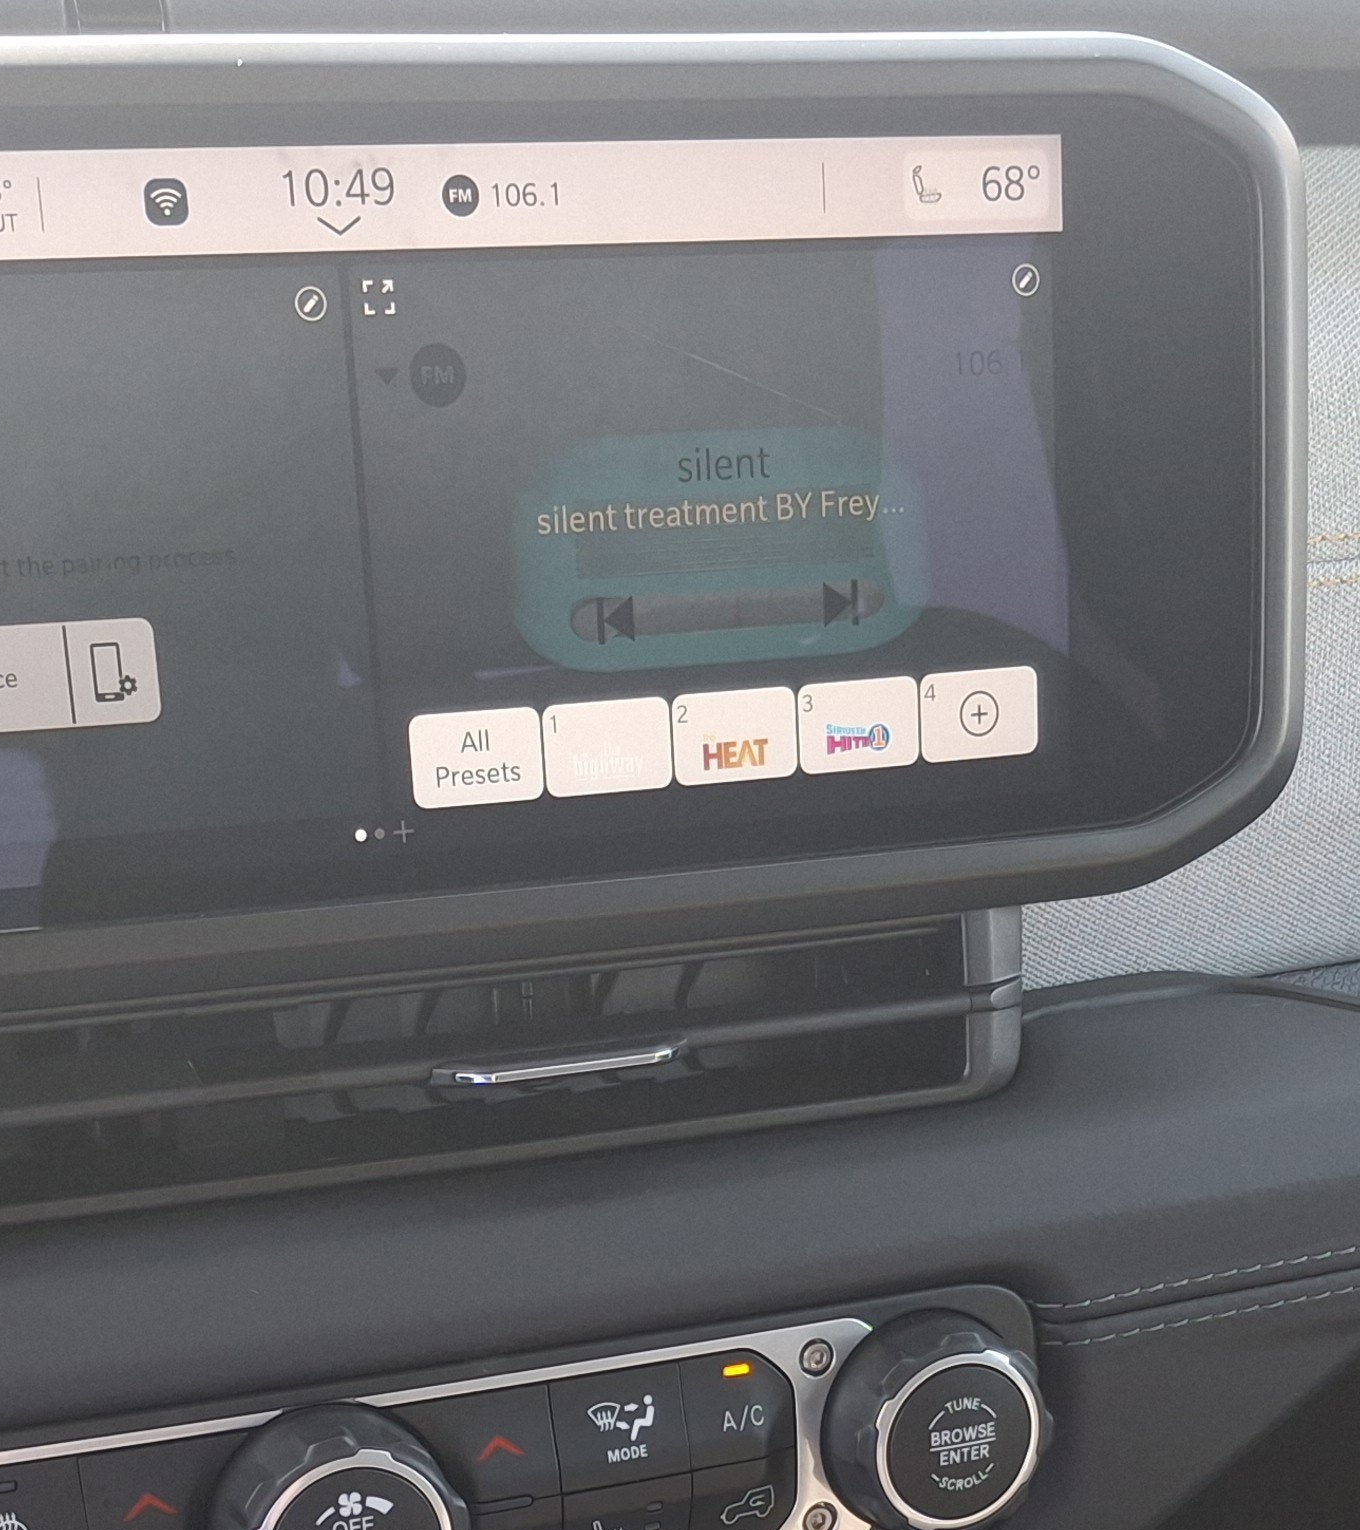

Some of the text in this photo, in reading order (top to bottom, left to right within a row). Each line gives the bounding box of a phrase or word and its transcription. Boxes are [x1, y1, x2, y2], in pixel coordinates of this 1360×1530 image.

[281, 165, 396, 208] 10:49
[447, 180, 561, 208] FM 106.1
[980, 164, 1041, 202] 68°
[419, 363, 455, 387] FM
[676, 446, 772, 484] silent
[536, 502, 618, 535] silent
[623, 495, 769, 531] treatment
[775, 491, 811, 520] BY
[17, 555, 54, 577] the
[61, 553, 141, 578] pairing
[801, 694, 814, 713] 3
[923, 683, 937, 702] 4
[549, 714, 559, 734] 1
[676, 704, 689, 724] 2
[460, 728, 491, 756] All
[702, 738, 769, 772] HEAT
[434, 760, 522, 790] Presets
[944, 1396, 982, 1414] TUNE
[722, 1403, 765, 1434] A/C
[930, 1421, 996, 1447] BROWSE
[607, 1444, 648, 1463] MODE
[939, 1444, 990, 1467] ENTER
[938, 1470, 989, 1491] SCROLL
